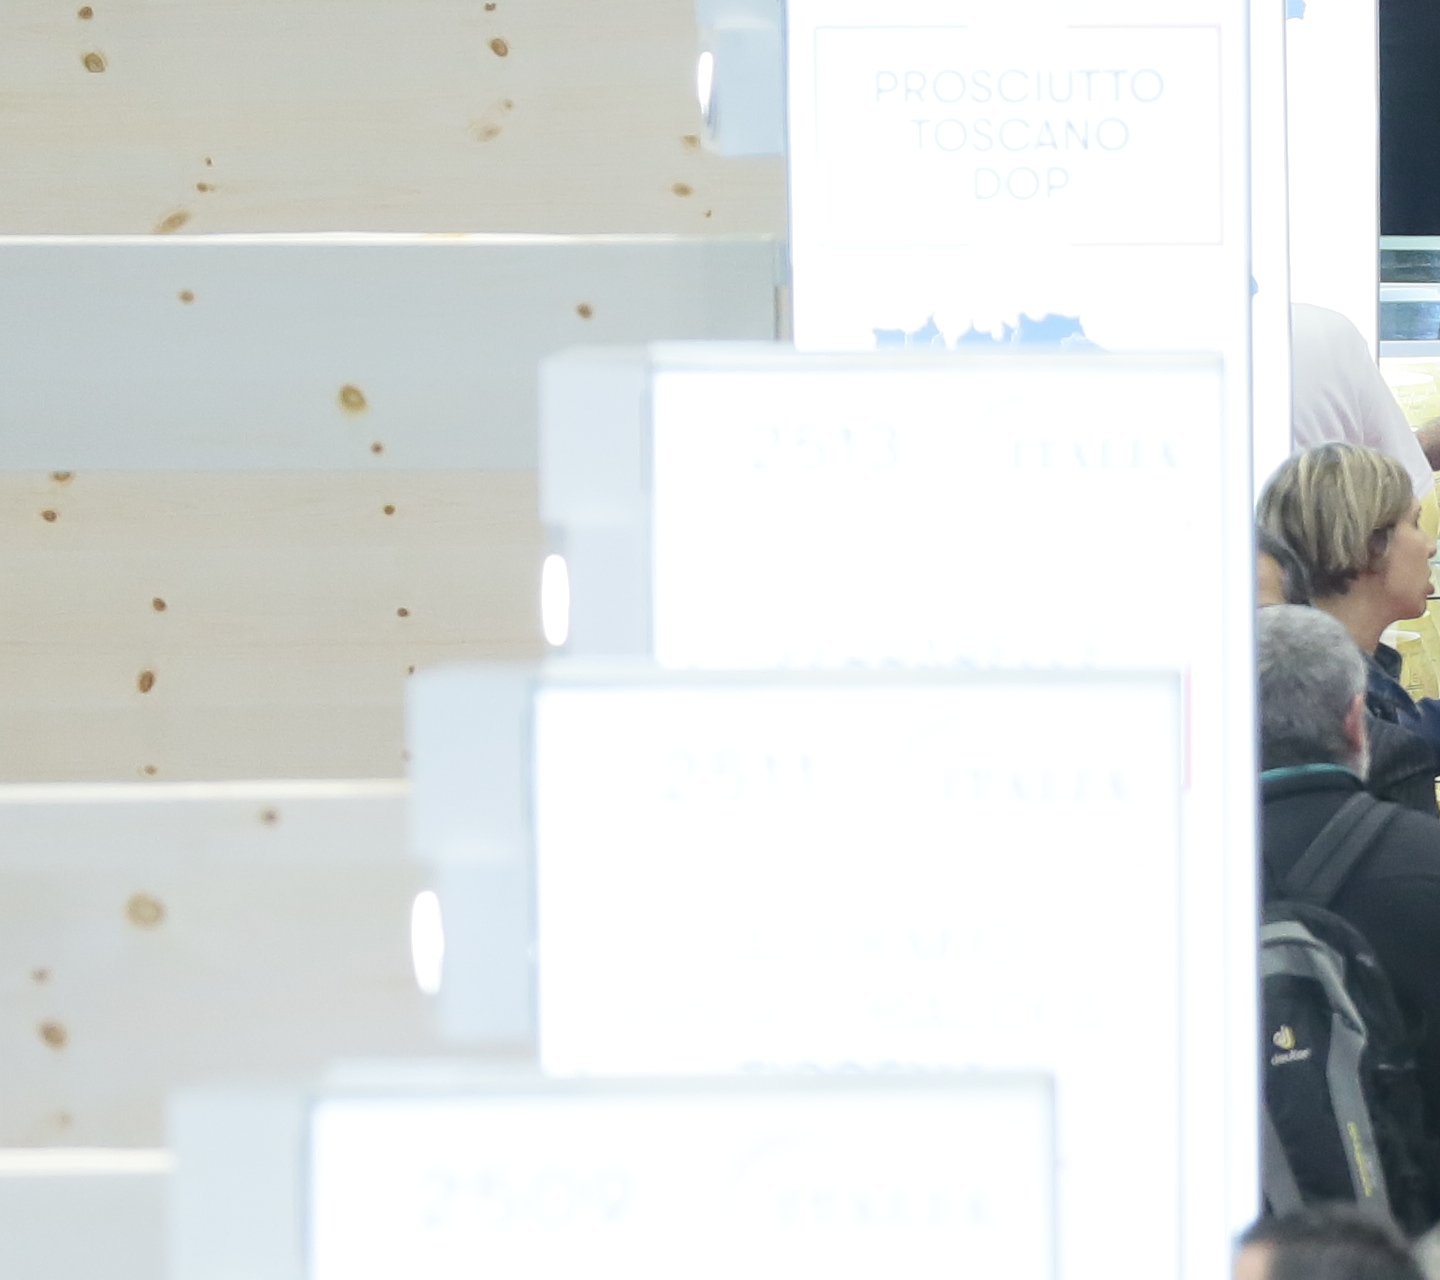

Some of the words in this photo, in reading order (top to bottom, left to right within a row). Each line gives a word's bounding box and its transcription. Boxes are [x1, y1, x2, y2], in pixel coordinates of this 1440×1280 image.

[875, 67, 1165, 104] PROSCIUTTO
[910, 116, 1130, 152] TOSCANO
[973, 165, 1070, 200] DOP
